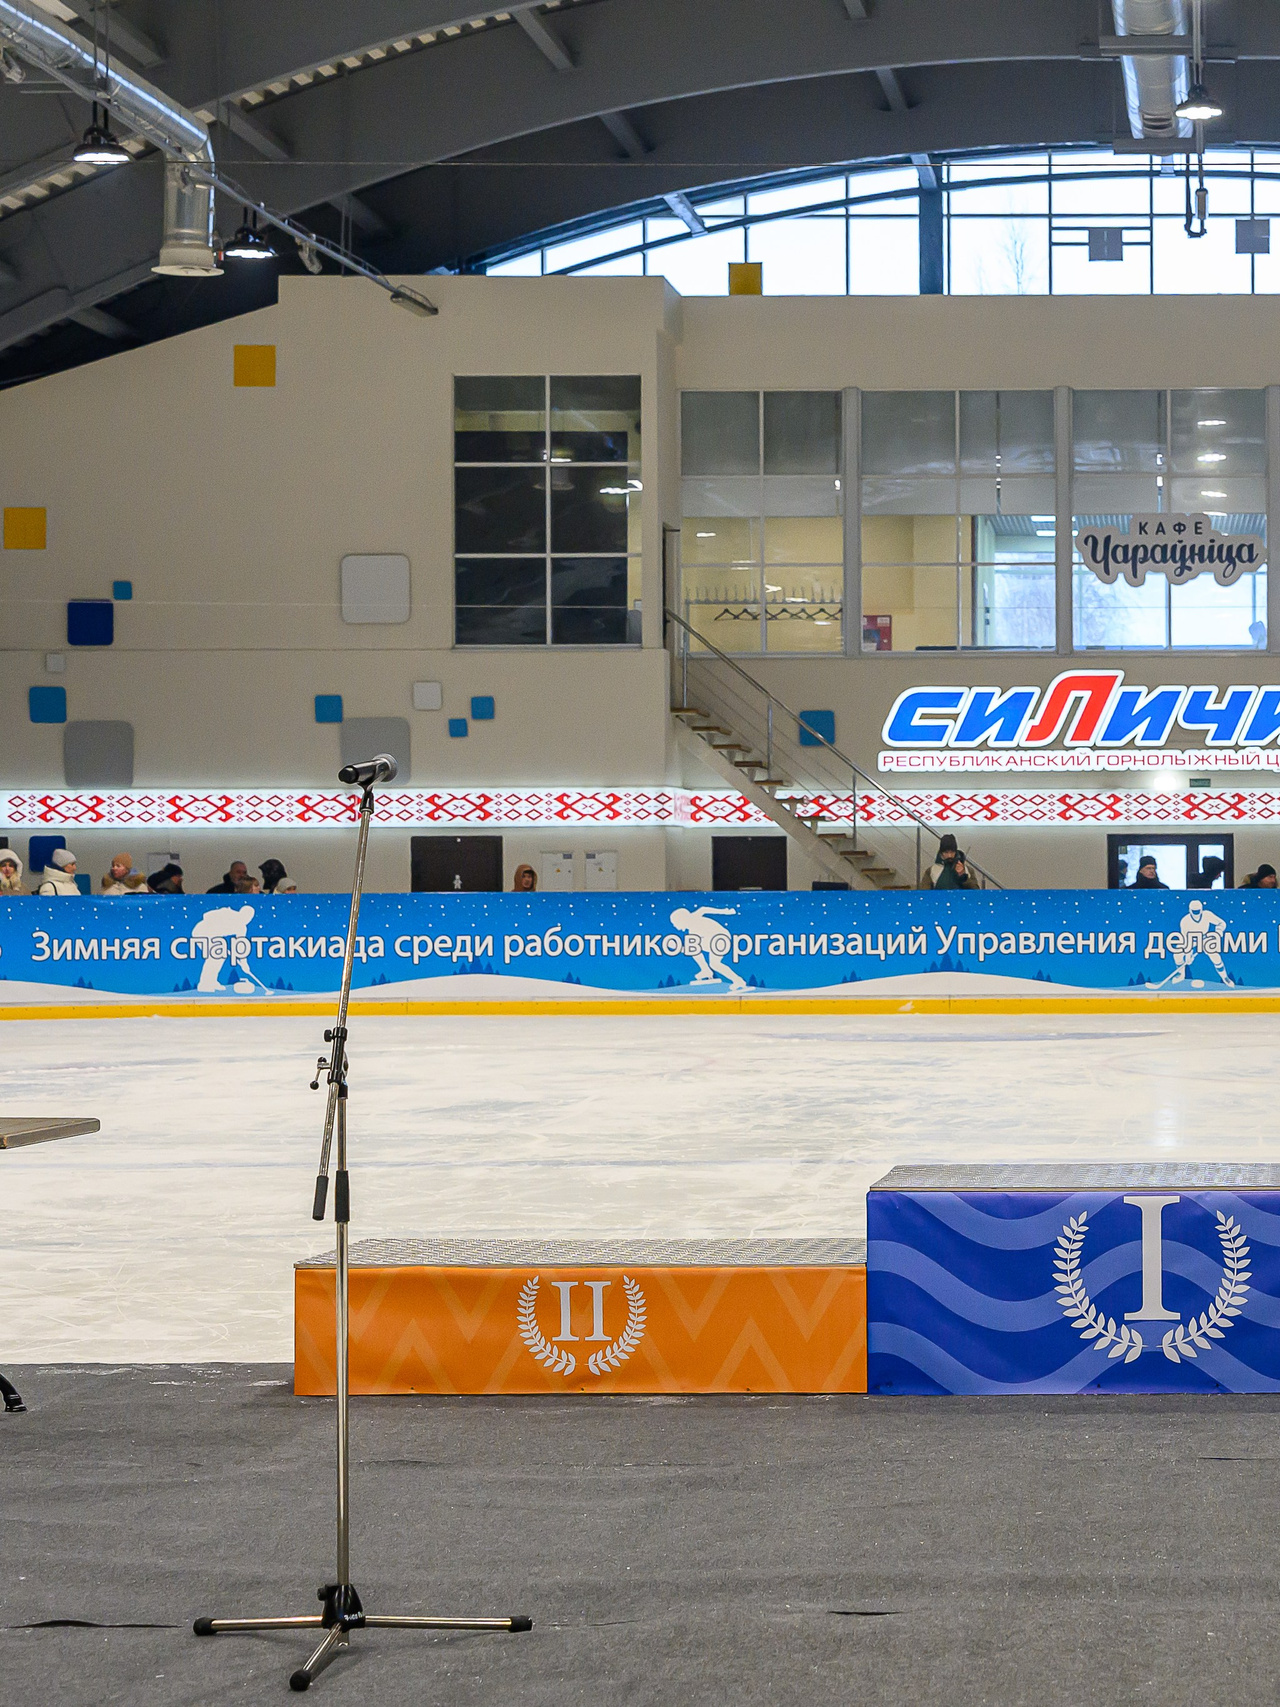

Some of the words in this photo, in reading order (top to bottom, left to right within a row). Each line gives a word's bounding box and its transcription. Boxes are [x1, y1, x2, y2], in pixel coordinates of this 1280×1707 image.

[1138, 521, 1204, 536] КАФЕ
[1083, 534, 1259, 578] Чараўніца
[883, 751, 1090, 768] РЕСПУБЛИКАНСКИЙ
[1096, 750, 1261, 768] ГОРНОЛЫЖНЫЙ
[31, 930, 160, 961] Зимняя
[170, 934, 386, 966] спартакиада
[393, 933, 495, 965] среди
[505, 926, 703, 965] работников
[708, 926, 927, 961] организаций
[936, 925, 1136, 962] Управления
[1144, 930, 1266, 959] делами
[1123, 1196, 1181, 1322] I
[549, 1281, 611, 1342] II
